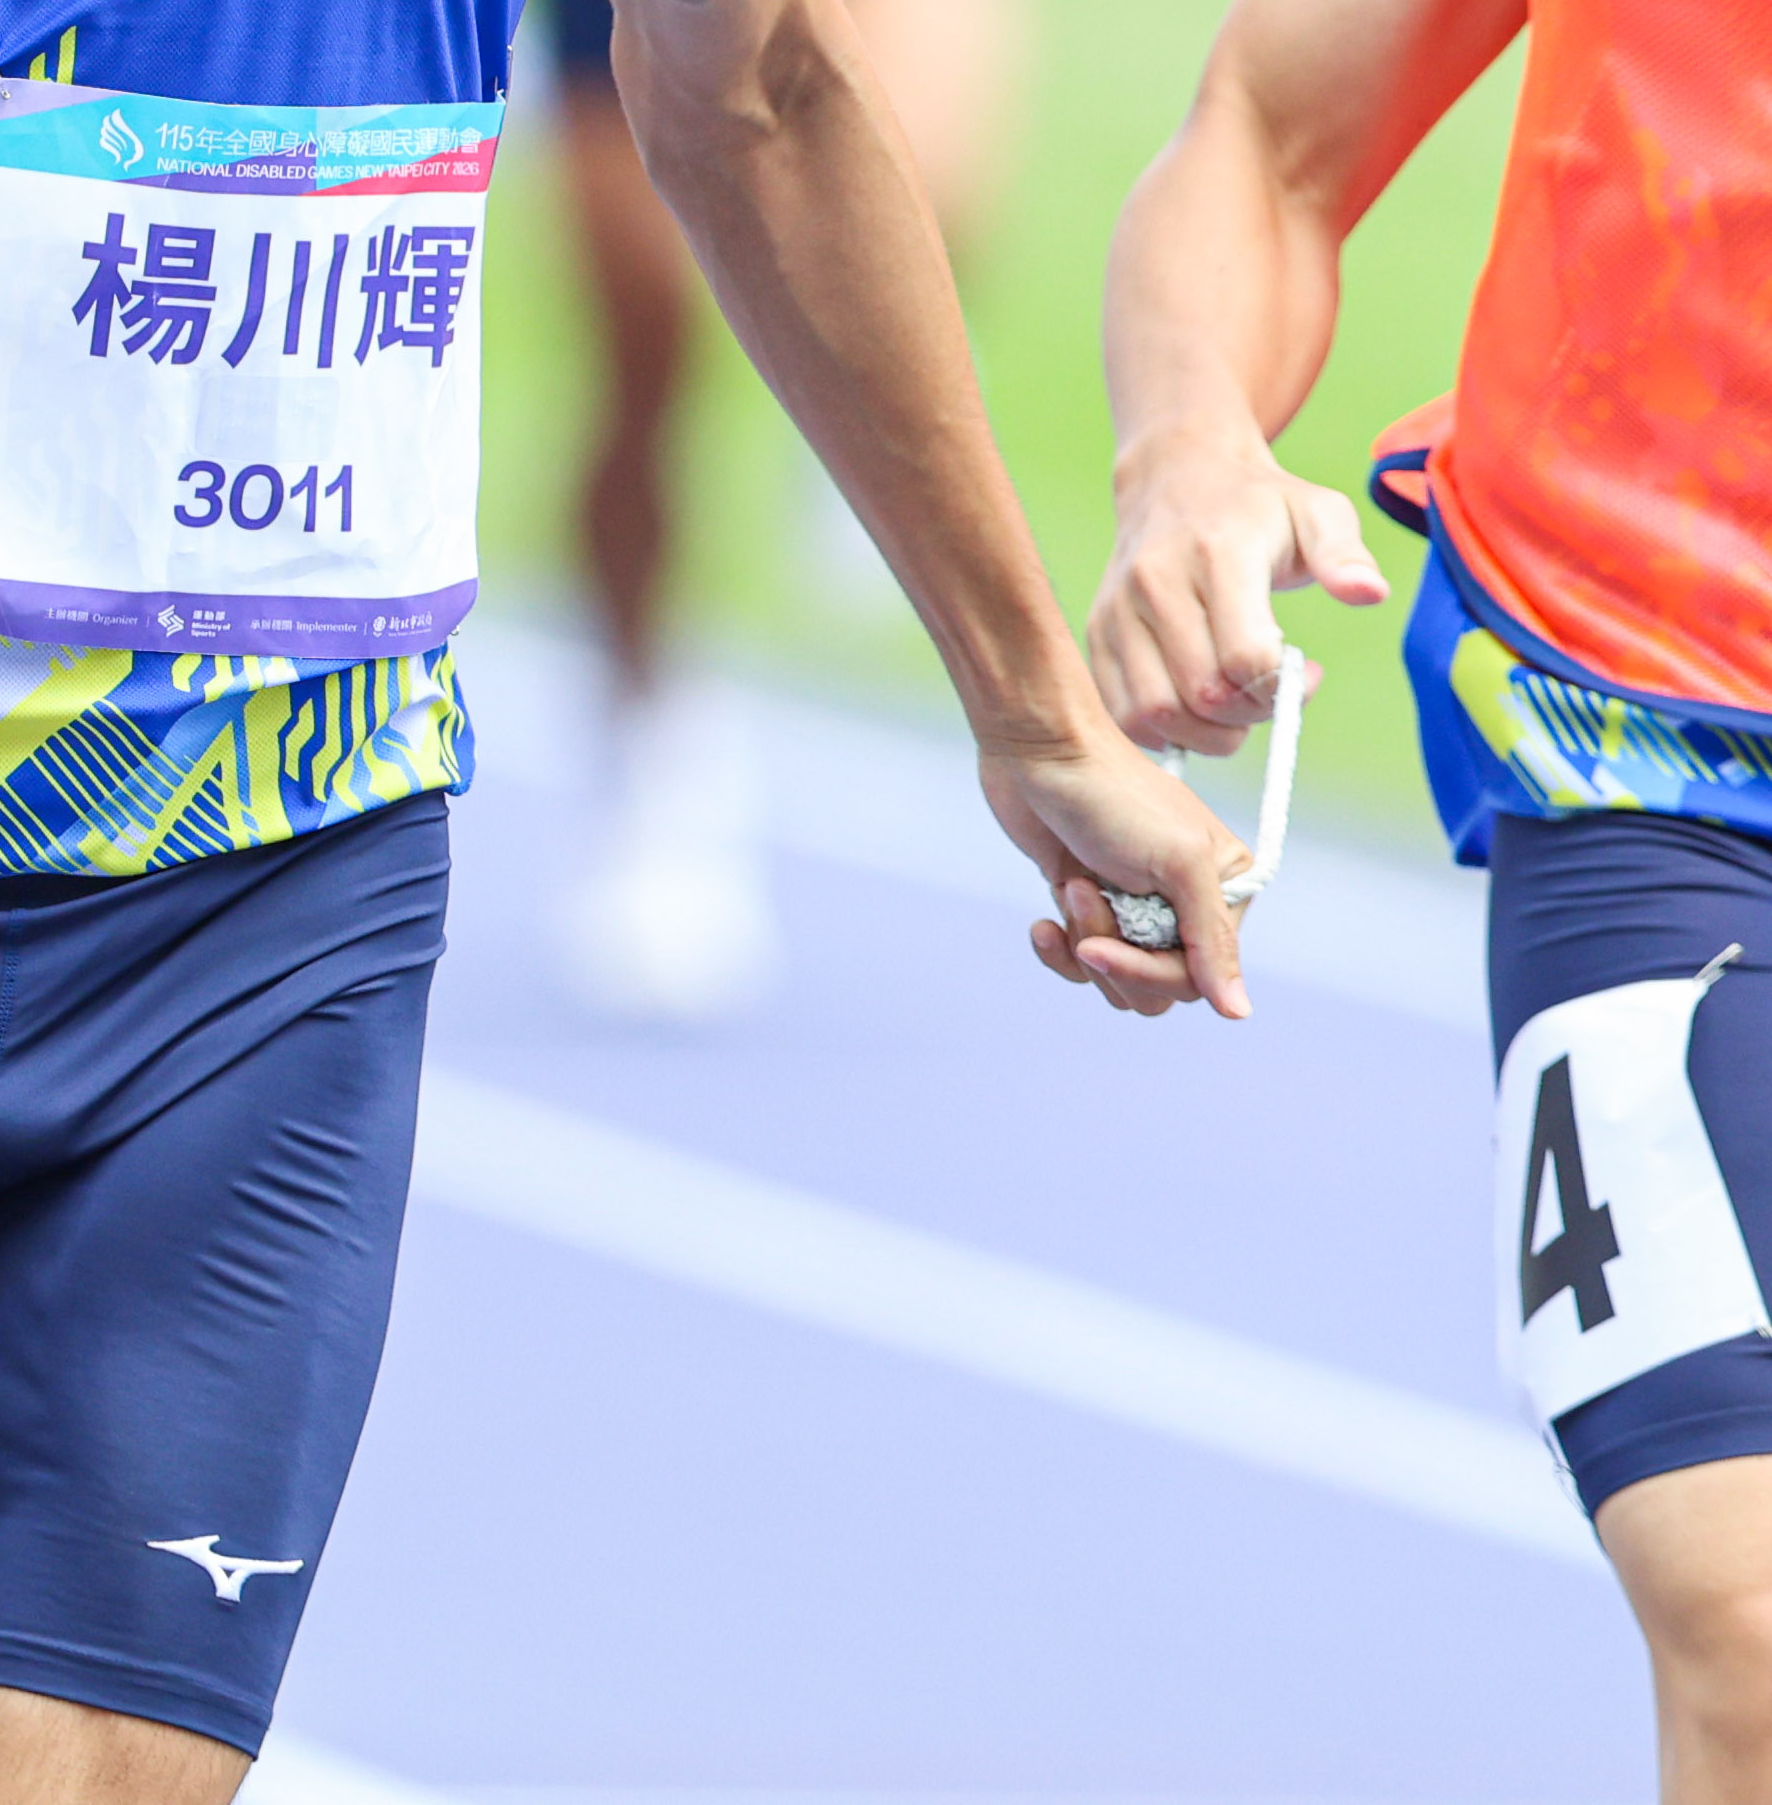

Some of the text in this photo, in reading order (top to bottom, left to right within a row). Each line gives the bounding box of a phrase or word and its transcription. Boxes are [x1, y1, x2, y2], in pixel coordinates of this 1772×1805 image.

[156, 157, 480, 180] NATIONAL DISABLED GAMES NEW TAIPEI CITY 2026
[72, 211, 476, 369] 楊川輝
[172, 459, 354, 533] 3011
[92, 612, 138, 626] Organizer
[191, 622, 231, 632] Ministry of
[296, 621, 358, 633] Implementer
[190, 630, 217, 638] Sports
[1520, 1052, 1621, 1334] 4
